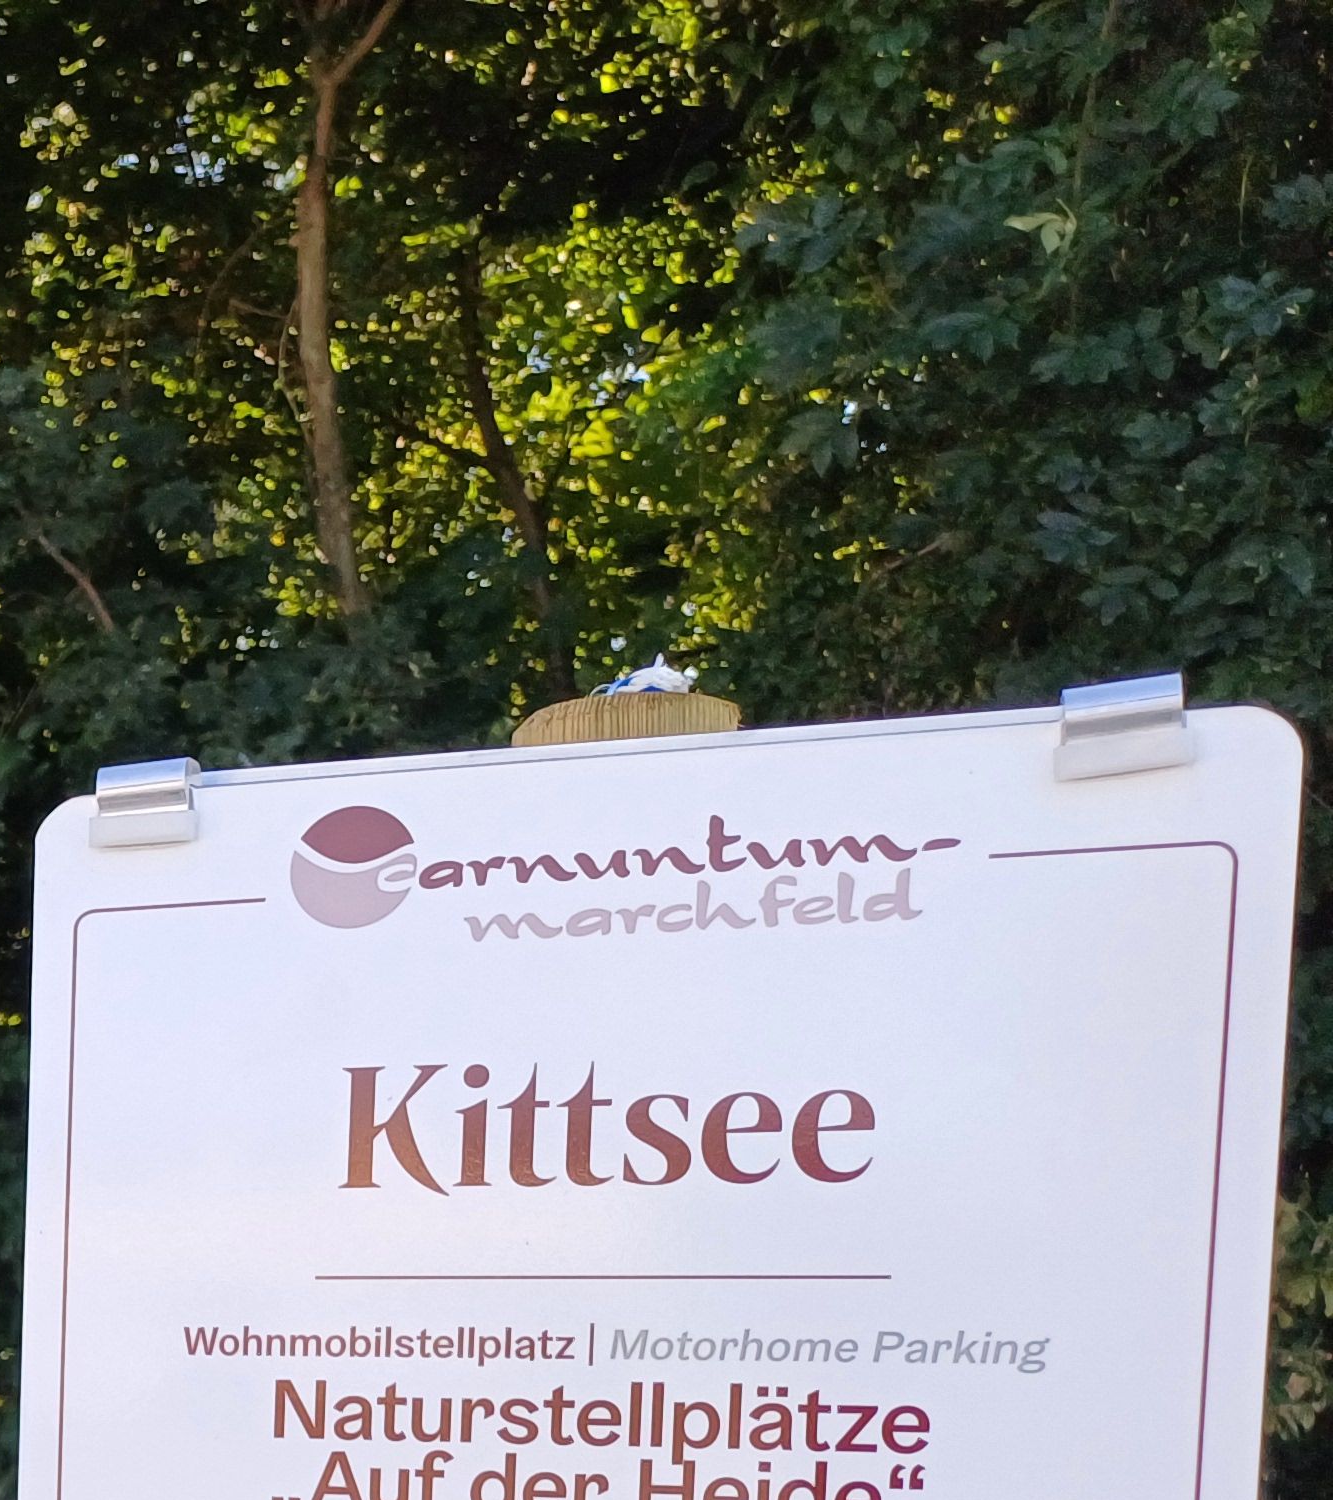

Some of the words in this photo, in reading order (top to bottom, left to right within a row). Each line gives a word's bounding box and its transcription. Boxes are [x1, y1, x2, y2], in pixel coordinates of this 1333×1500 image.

[464, 868, 923, 943] marchfeld
[338, 1061, 876, 1197] Kittsee
[183, 1325, 575, 1367] Wohnmobilstellplatz
[610, 1328, 859, 1363] Motorhome
[872, 1330, 1050, 1374] Parking
[273, 1379, 931, 1465] Naturstellplätze
